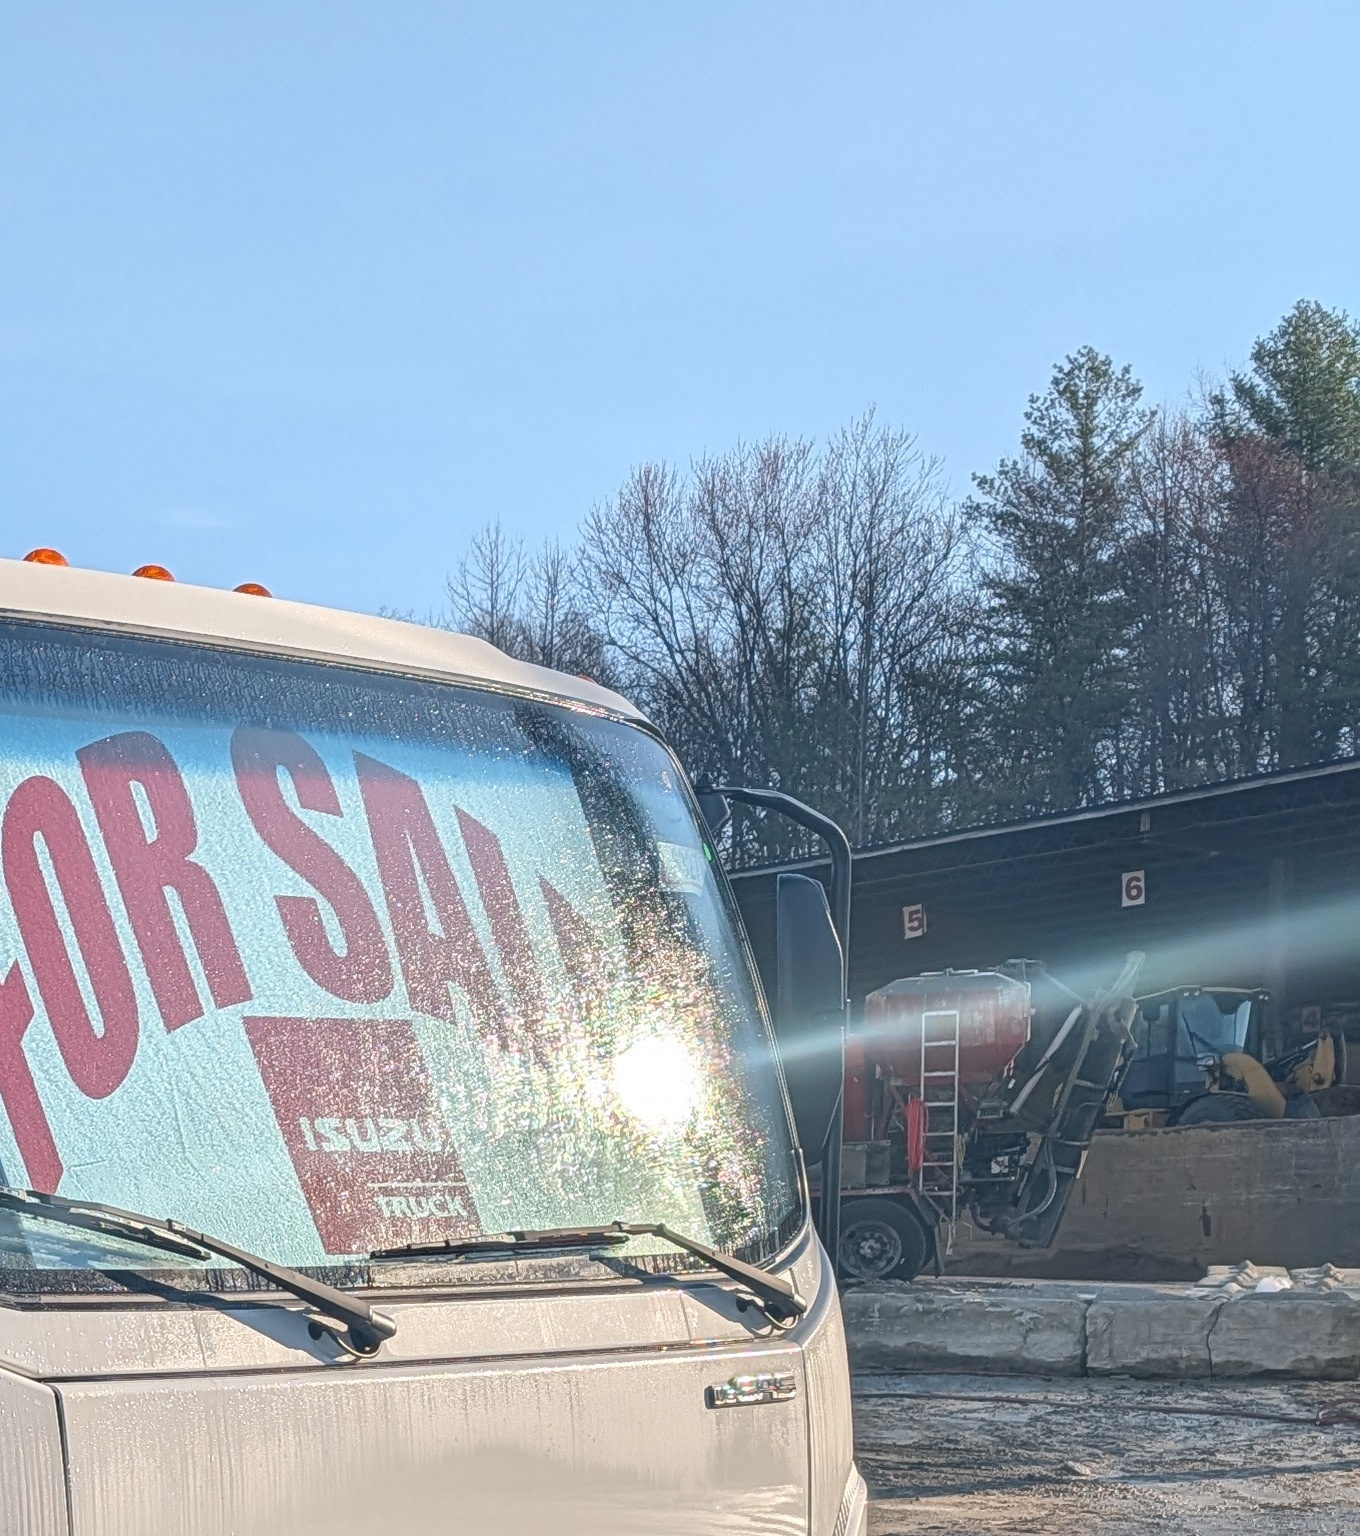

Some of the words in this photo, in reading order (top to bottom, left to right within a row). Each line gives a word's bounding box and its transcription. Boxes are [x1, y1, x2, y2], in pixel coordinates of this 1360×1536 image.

[230, 726, 592, 1075] SAL
[1124, 875, 1143, 901] 6
[907, 908, 923, 932] 5
[1303, 1008, 1318, 1029] 4
[298, 1115, 449, 1153] ISUZU
[373, 1193, 468, 1219] TRUCK
